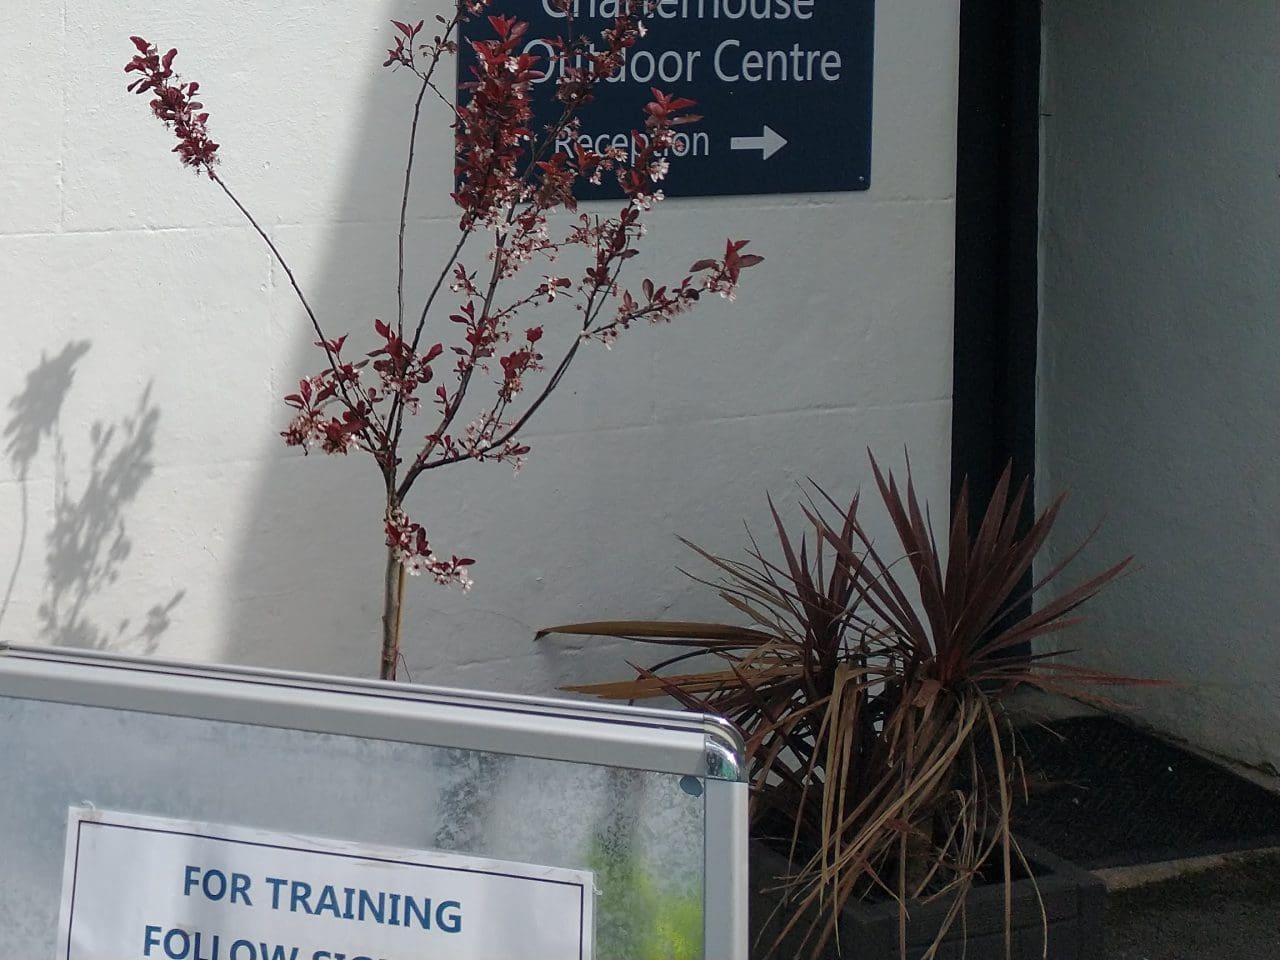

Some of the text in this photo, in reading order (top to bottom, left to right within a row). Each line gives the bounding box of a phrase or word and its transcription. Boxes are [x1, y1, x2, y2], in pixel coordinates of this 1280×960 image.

[714, 40, 841, 82] Centre
[183, 865, 462, 933] FOR TRAINING
